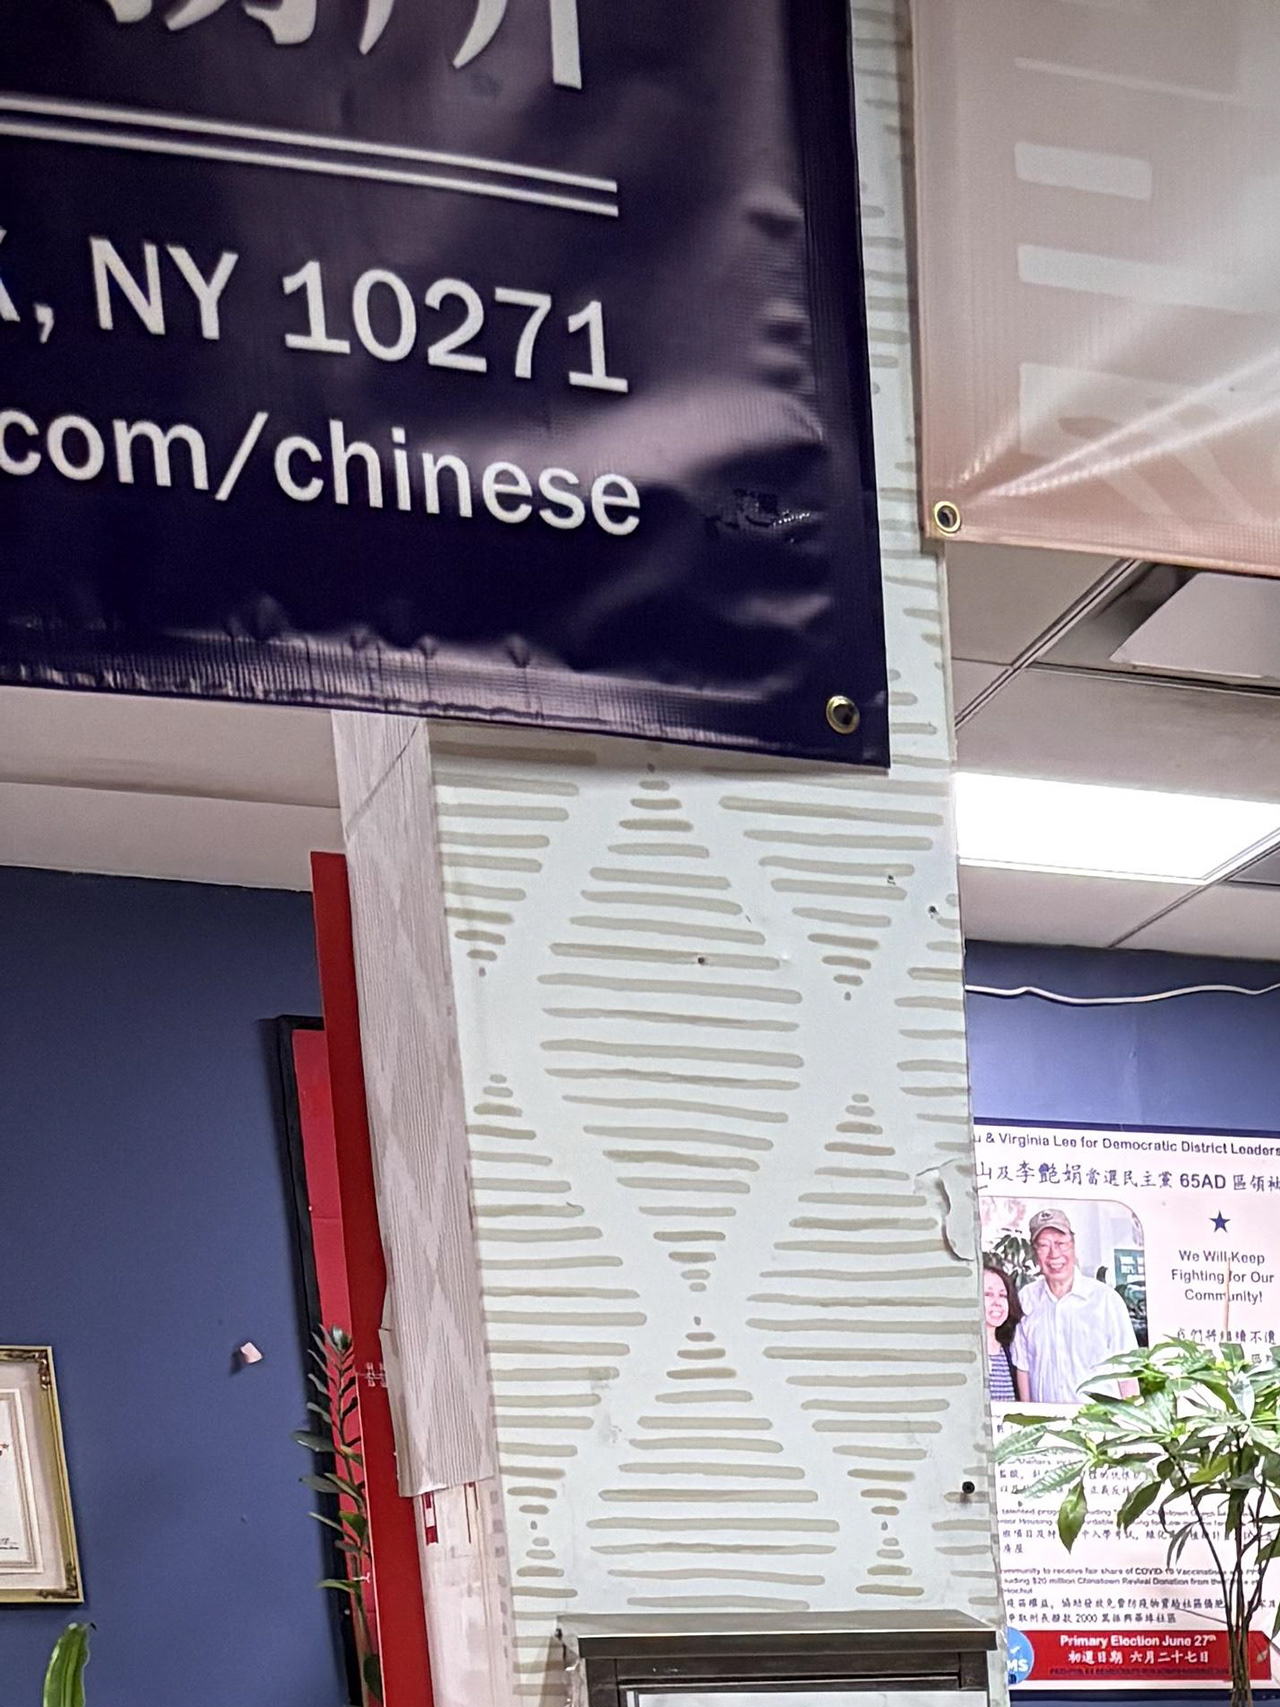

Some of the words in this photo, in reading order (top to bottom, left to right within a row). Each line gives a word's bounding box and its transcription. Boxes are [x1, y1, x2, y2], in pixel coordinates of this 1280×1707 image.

[90, 236, 238, 342] NY
[283, 261, 629, 394] 10271
[986, 1132, 995, 1144] &
[999, 1132, 1049, 1149] Virginia
[1054, 1135, 1077, 1149] Lee
[1081, 1136, 1097, 1148] for
[1103, 1138, 1177, 1154] Democratic
[1182, 1140, 1227, 1155] District
[1180, 1172, 1226, 1190] 65AD
[1179, 1249, 1200, 1262] We
[1203, 1249, 1227, 1262] Will
[1231, 1250, 1265, 1265] Keep
[1171, 1269, 1224, 1285] Fighting
[1251, 1271, 1275, 1285] Our
[1076, 1612, 1097, 1624] 2000
[1060, 1634, 1107, 1649] Primary
[1110, 1635, 1159, 1647] Election
[1162, 1635, 1191, 1647] June
[1130, 1650, 1210, 1664] 六月二十七日
